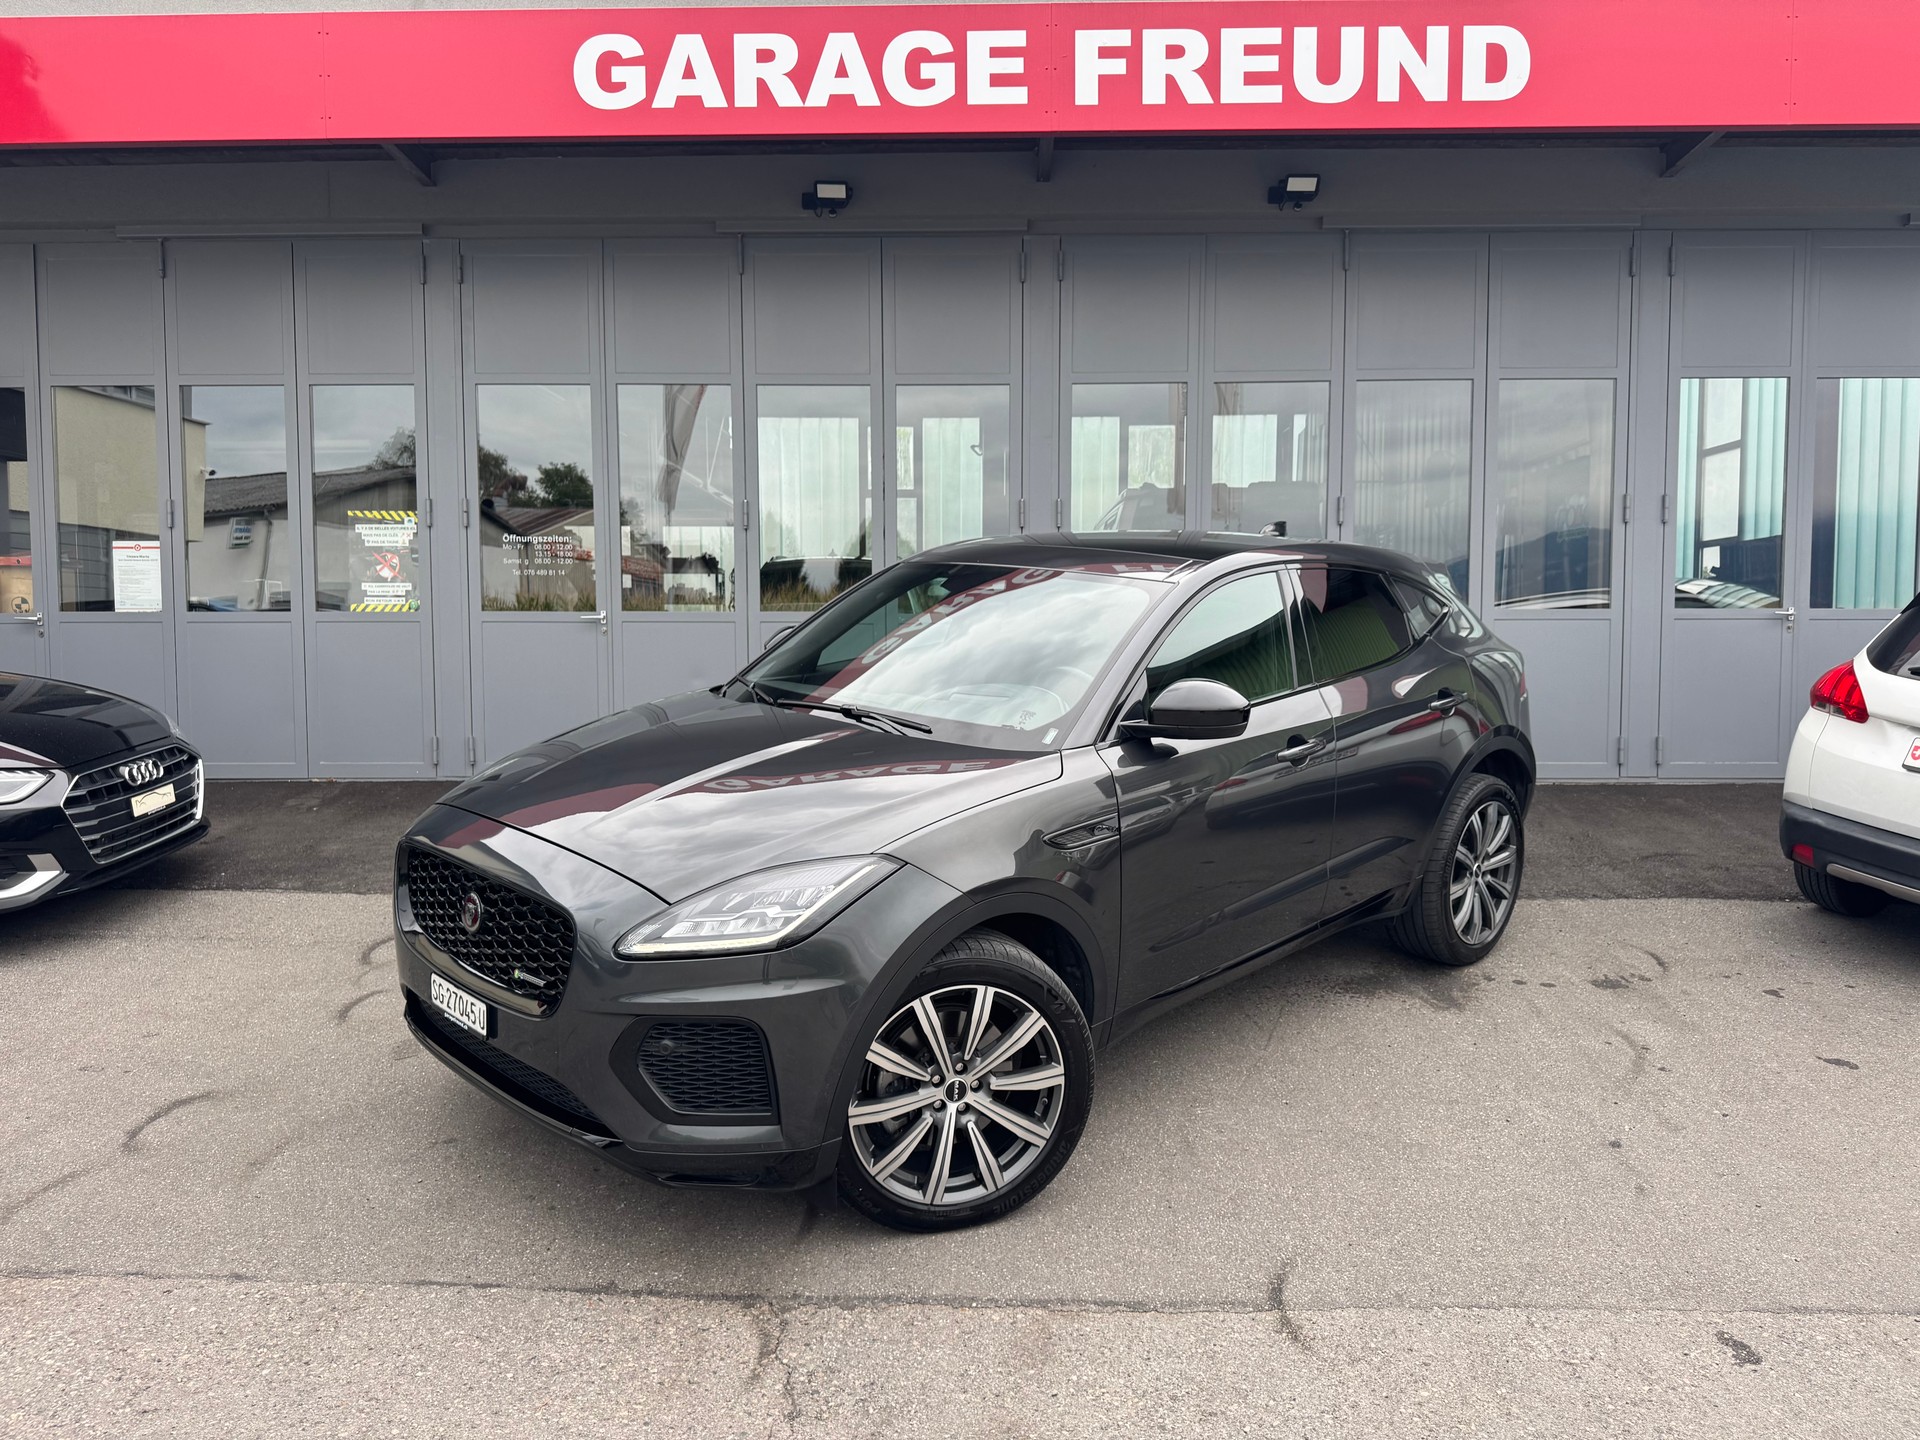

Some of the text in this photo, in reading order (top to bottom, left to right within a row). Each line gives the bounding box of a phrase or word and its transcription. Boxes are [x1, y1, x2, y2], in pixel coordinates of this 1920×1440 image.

[572, 24, 1532, 111] GARAGE FREUND
[502, 533, 572, 544] Öffnungszeiten:
